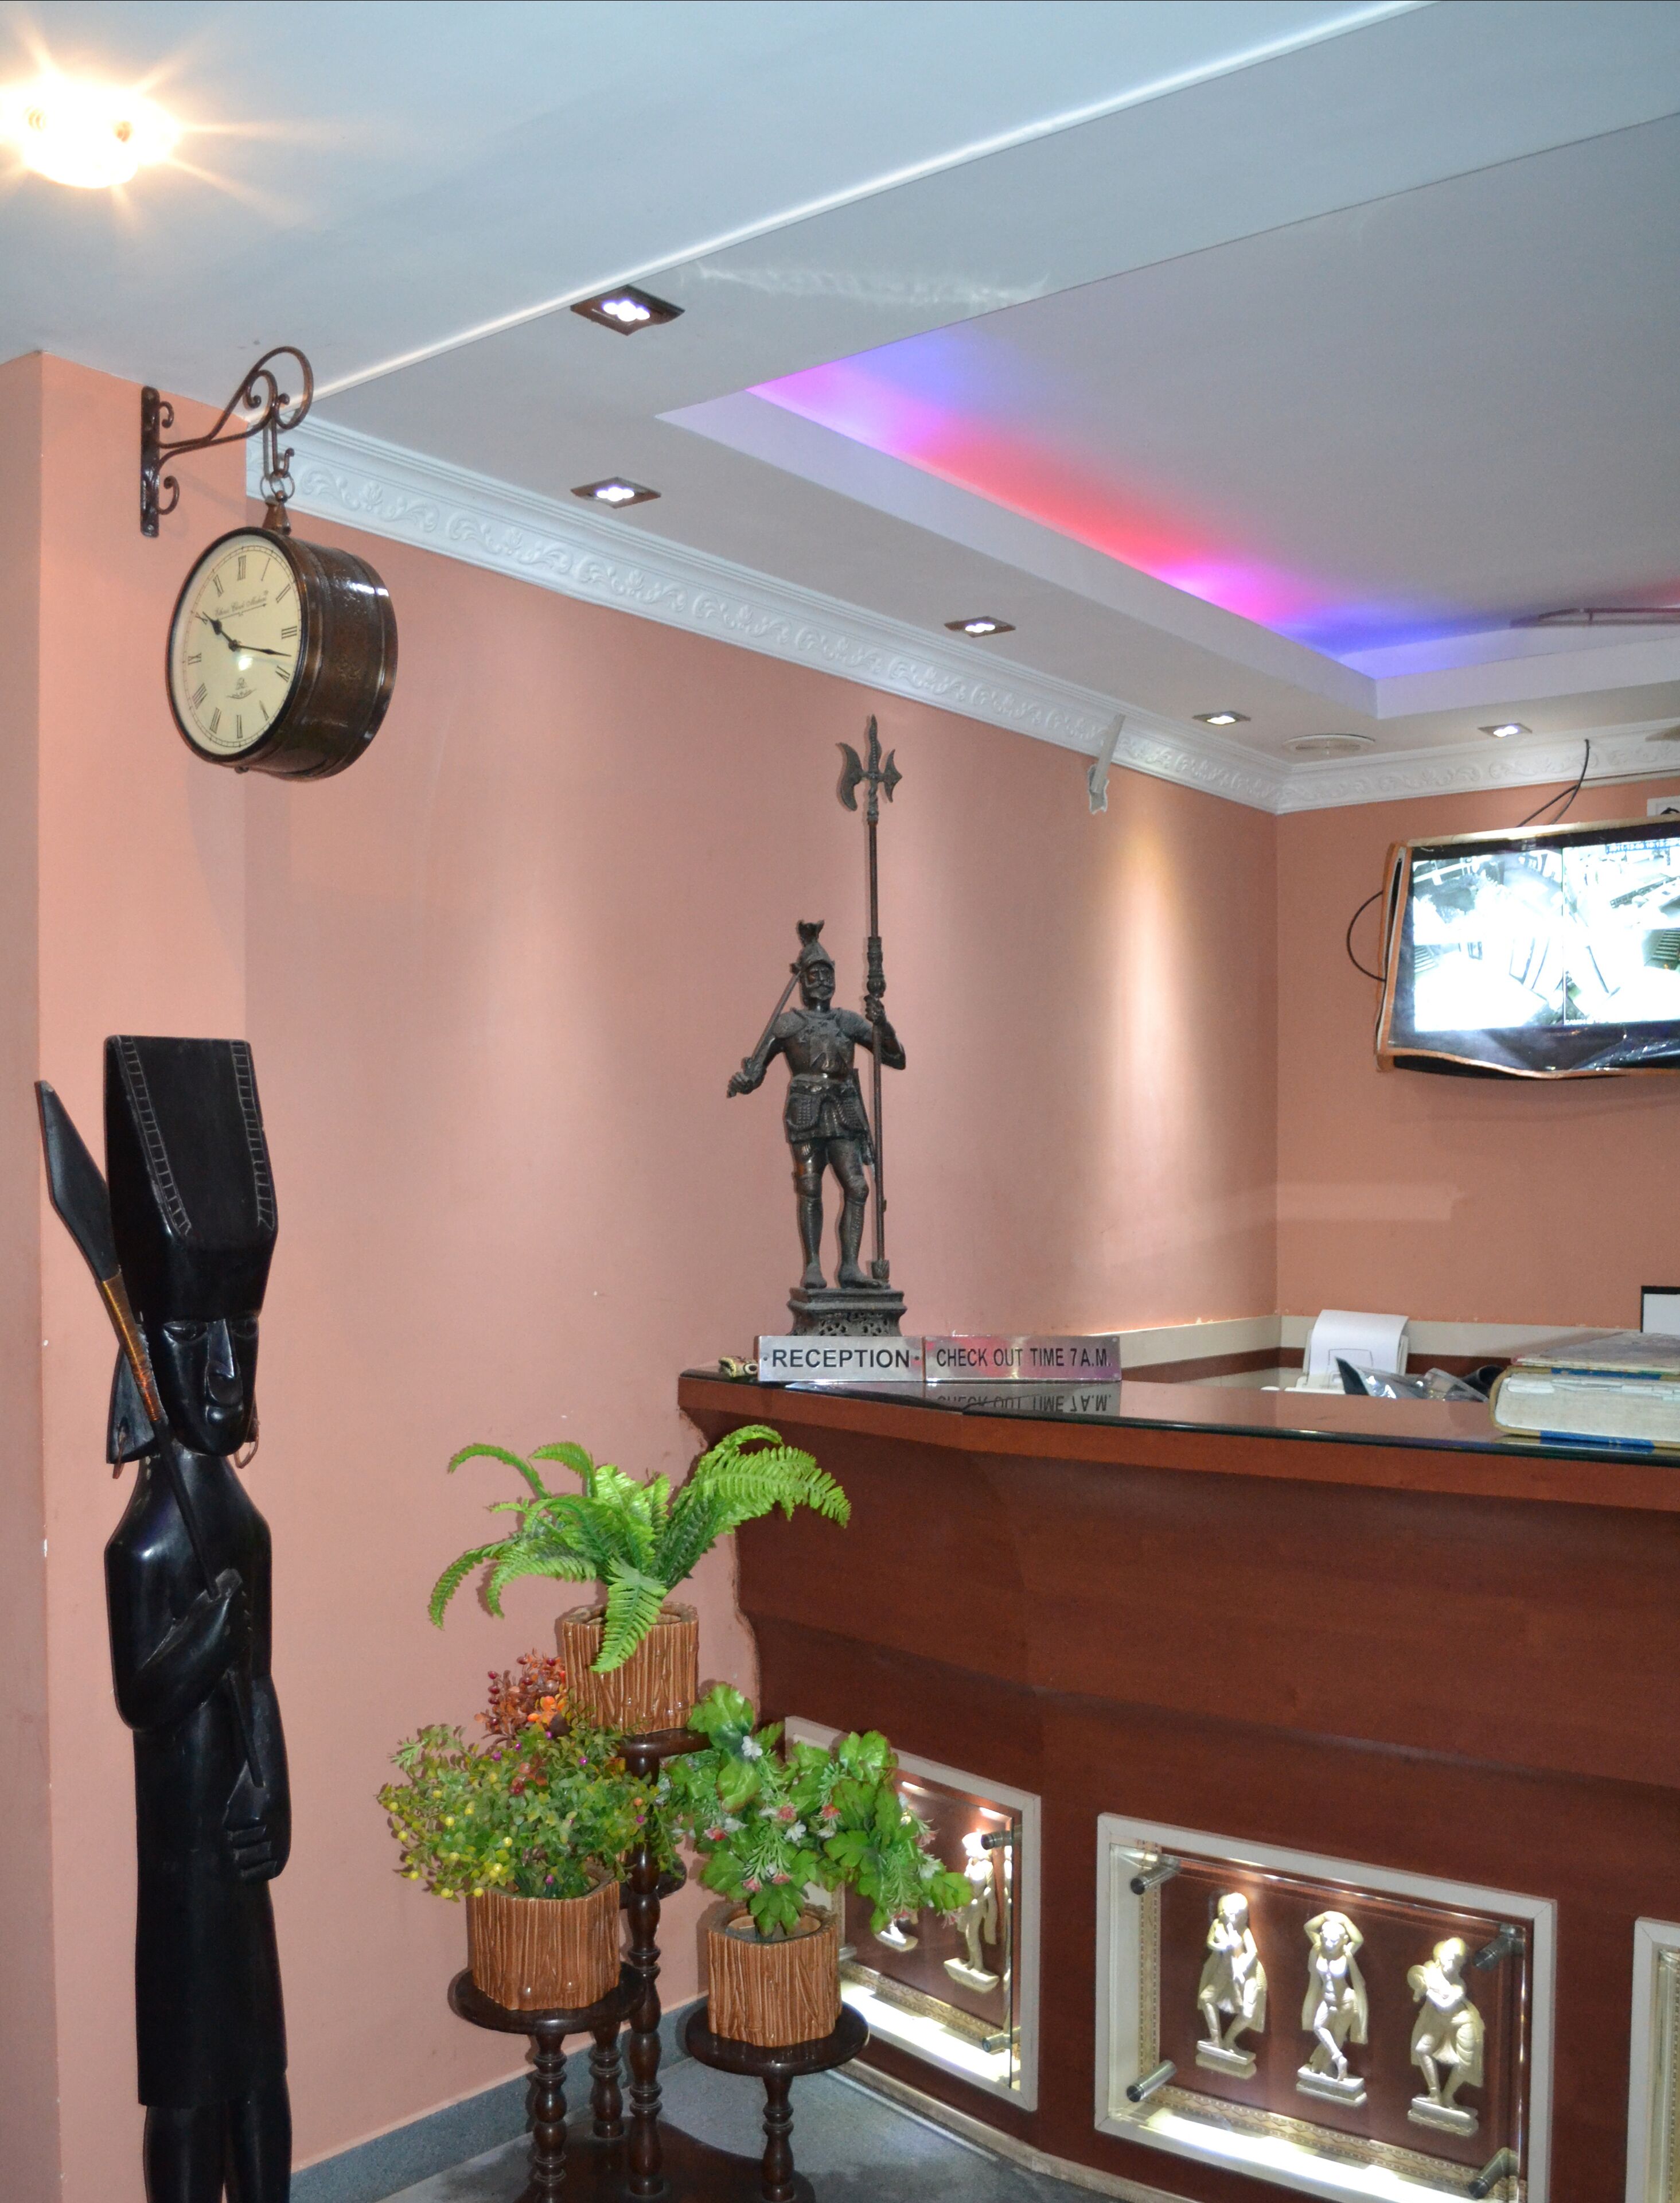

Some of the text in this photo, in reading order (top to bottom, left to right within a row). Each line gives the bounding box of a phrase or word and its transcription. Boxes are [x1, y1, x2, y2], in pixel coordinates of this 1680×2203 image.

[237, 555, 246, 581] XII
[213, 574, 224, 597] XI
[281, 625, 298, 639] III
[772, 1349, 910, 1368] RECEPTION
[936, 1348, 988, 1367] CHECK
[993, 1348, 1023, 1367] OUT
[1030, 1348, 1065, 1367] TIME
